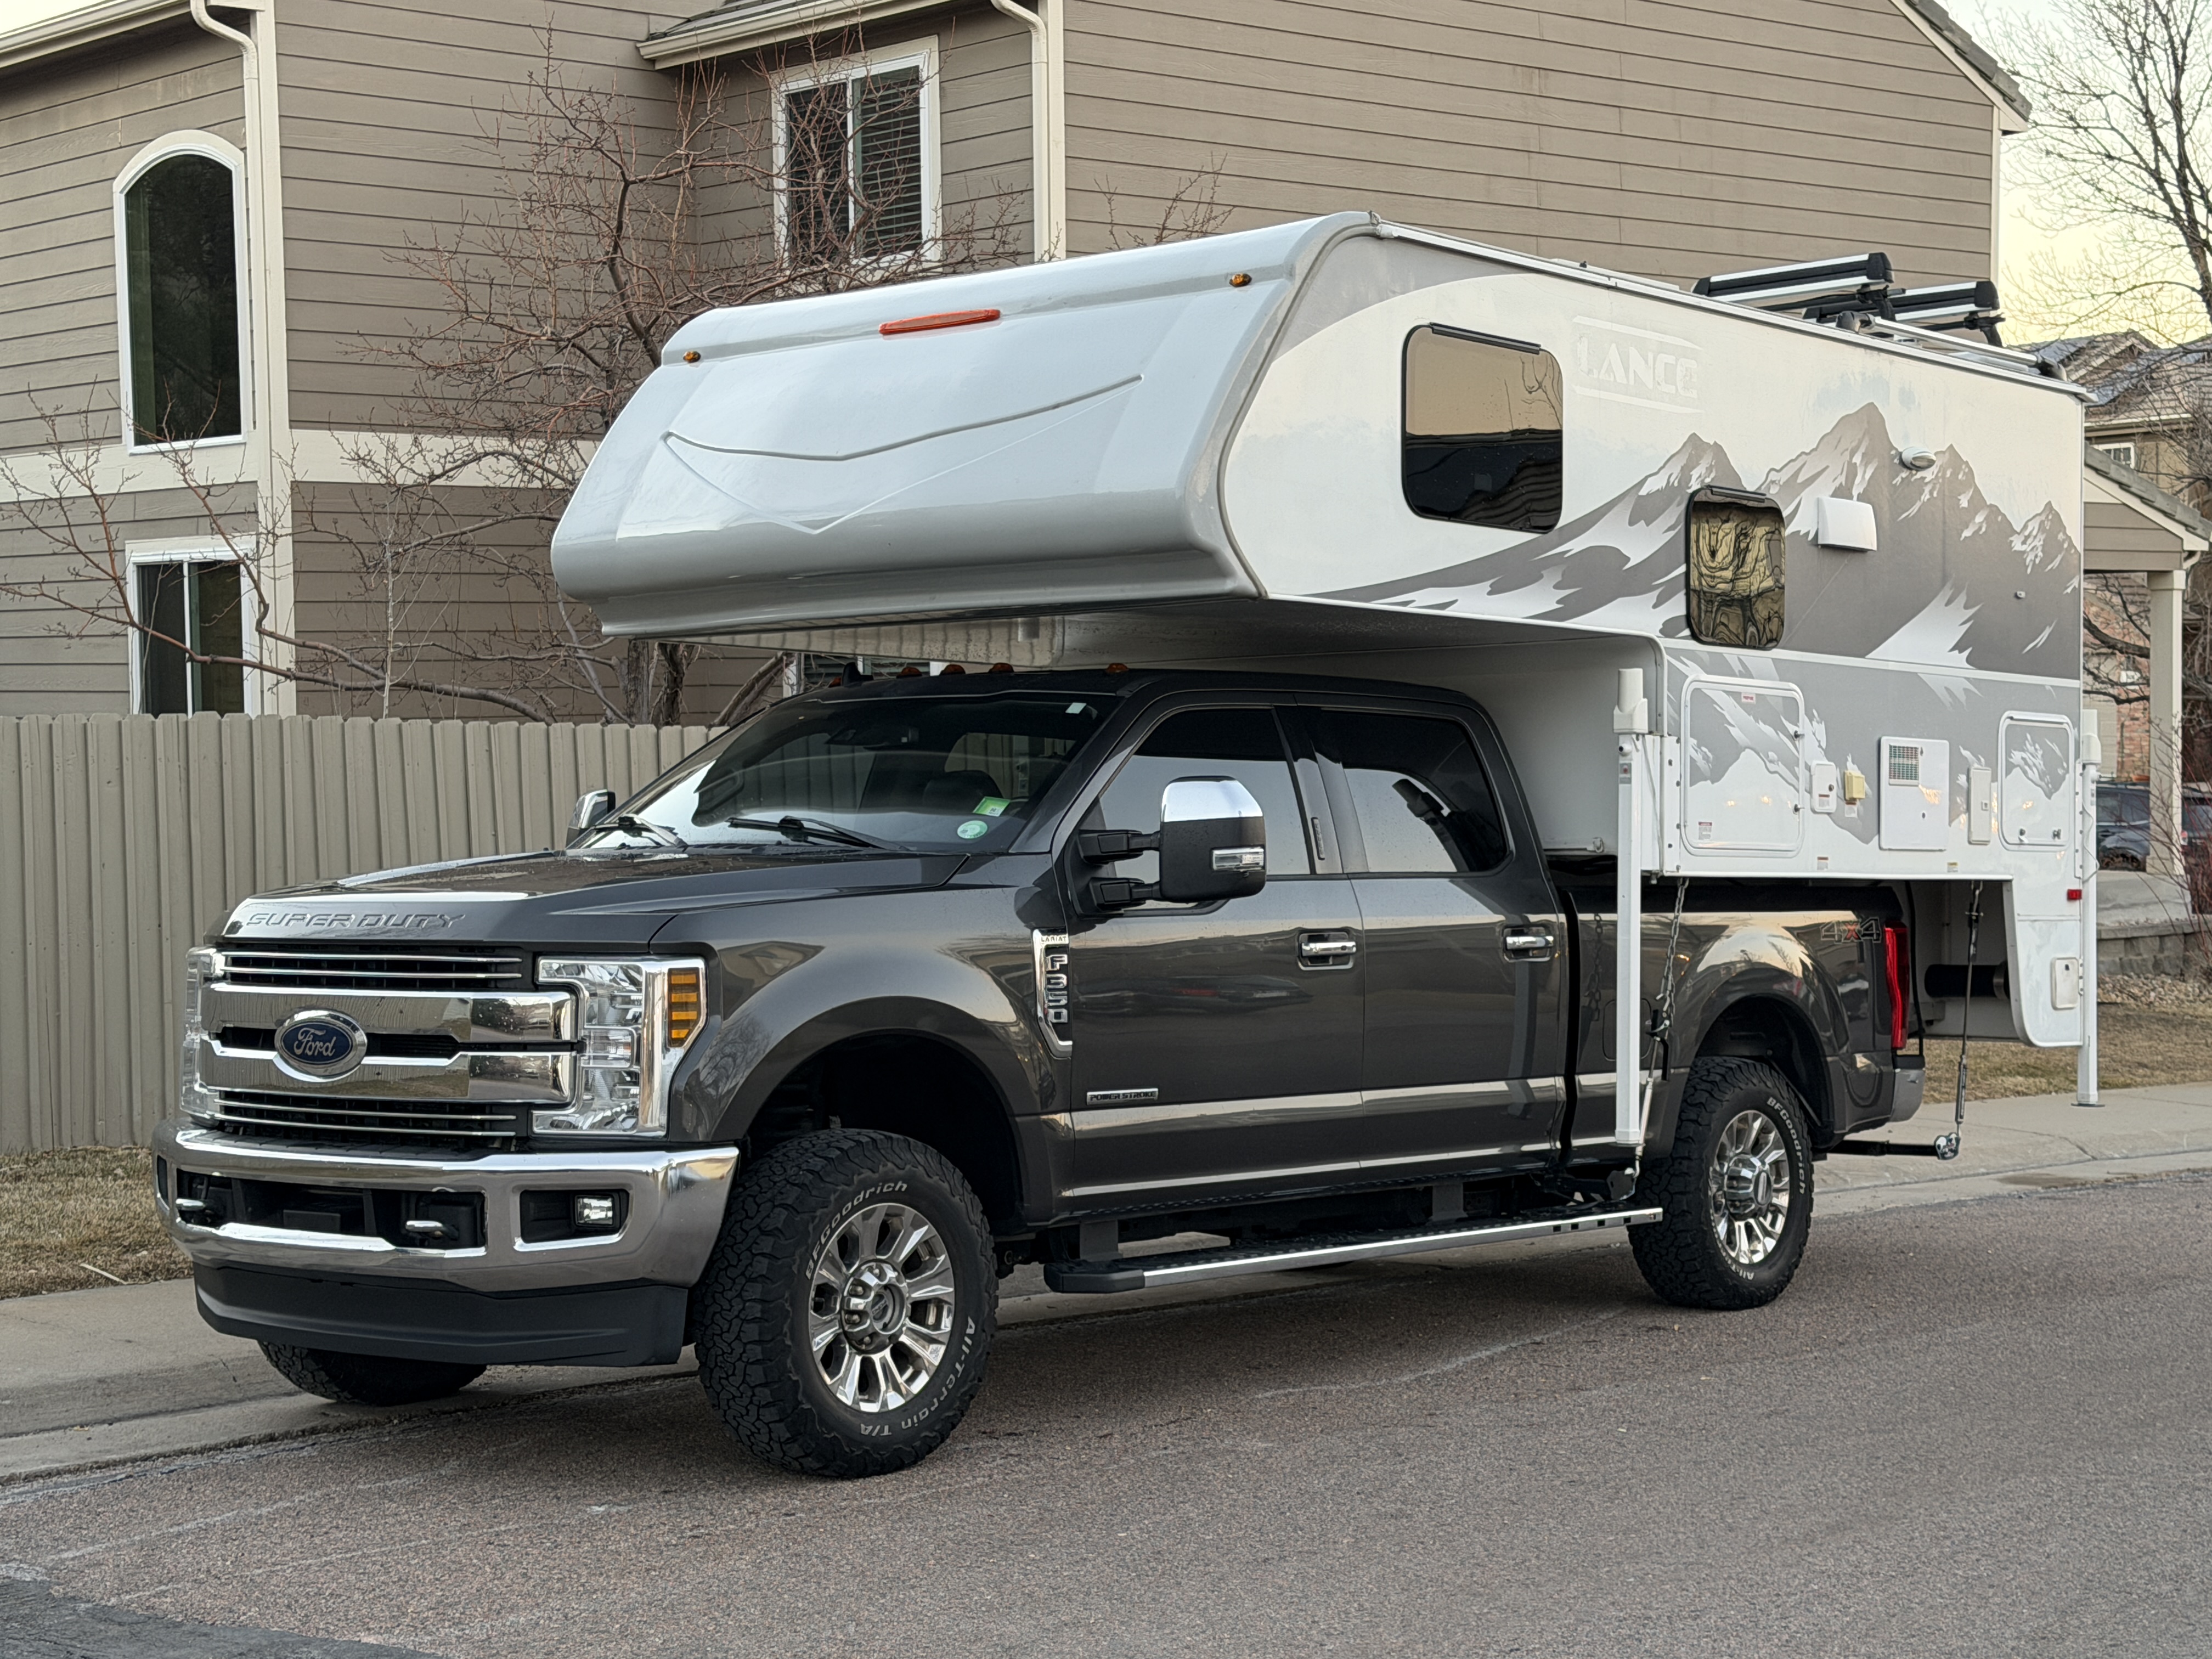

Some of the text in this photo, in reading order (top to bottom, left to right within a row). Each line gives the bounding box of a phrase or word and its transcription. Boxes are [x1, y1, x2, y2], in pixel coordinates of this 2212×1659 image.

[1577, 336, 1697, 398] LANCE
[246, 913, 466, 929] SUPER DUTY
[293, 1027, 337, 1057] Ford
[1767, 1096, 1806, 1195] BFGoodrich
[805, 1180, 909, 1281] BFGoodrich
[860, 1315, 976, 1437] All-Terrain T/A
